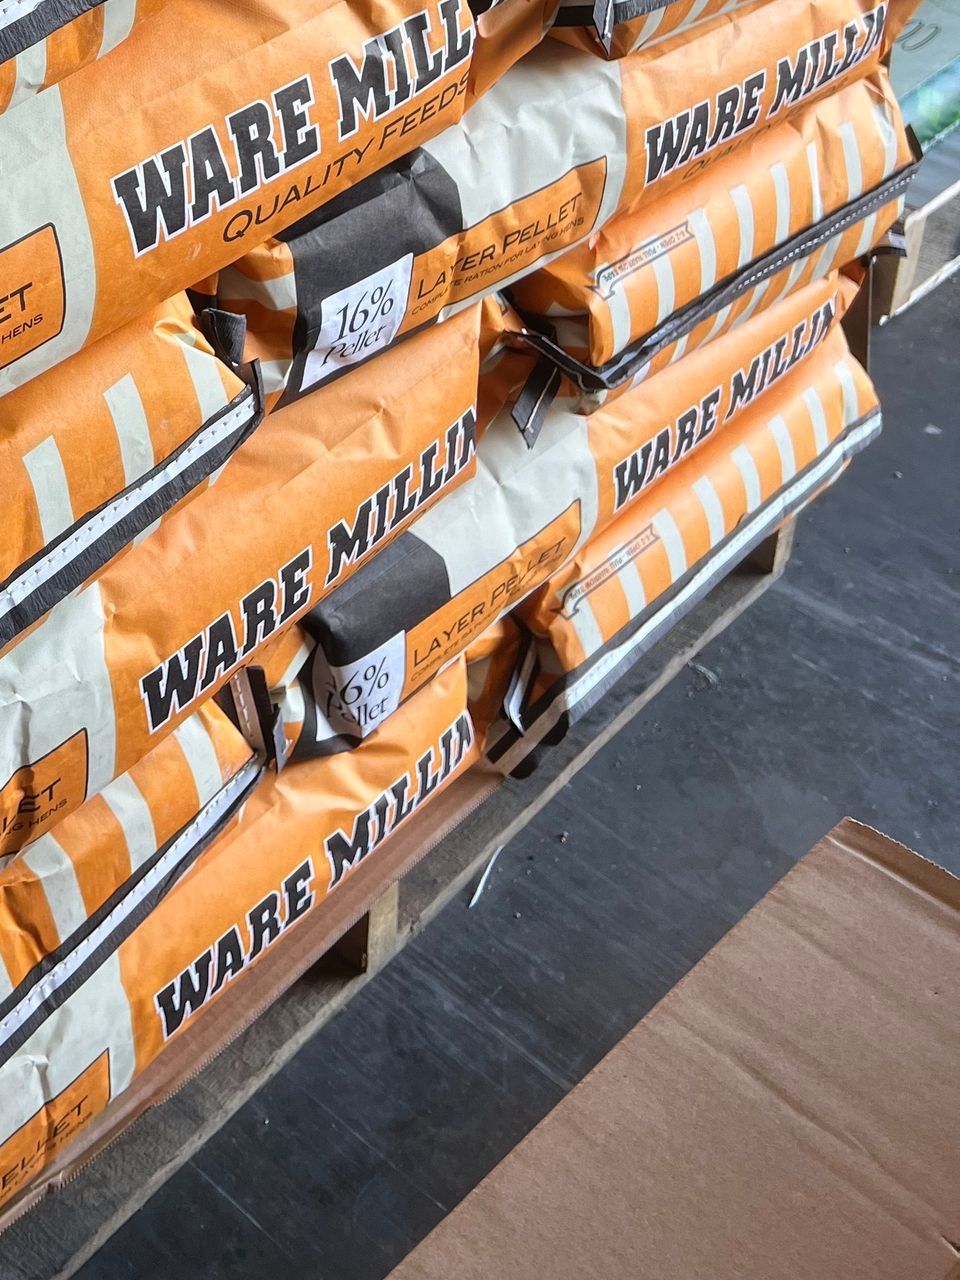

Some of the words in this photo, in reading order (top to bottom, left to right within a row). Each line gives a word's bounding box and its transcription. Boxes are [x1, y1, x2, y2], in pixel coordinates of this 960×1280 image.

[110, 73, 322, 259] WARE
[644, 69, 767, 188] WARE
[222, 135, 375, 244] QUALITY
[417, 244, 496, 300] LAYER
[502, 192, 582, 255] PELLET
[0, 312, 45, 346] HENS
[320, 323, 387, 368] Pellet
[330, 279, 394, 344] 16%
[612, 384, 723, 513] WARE
[138, 545, 314, 736] WARE
[414, 601, 486, 667] LAYER
[28, 798, 68, 828] HENS
[153, 855, 316, 1042] WARE
